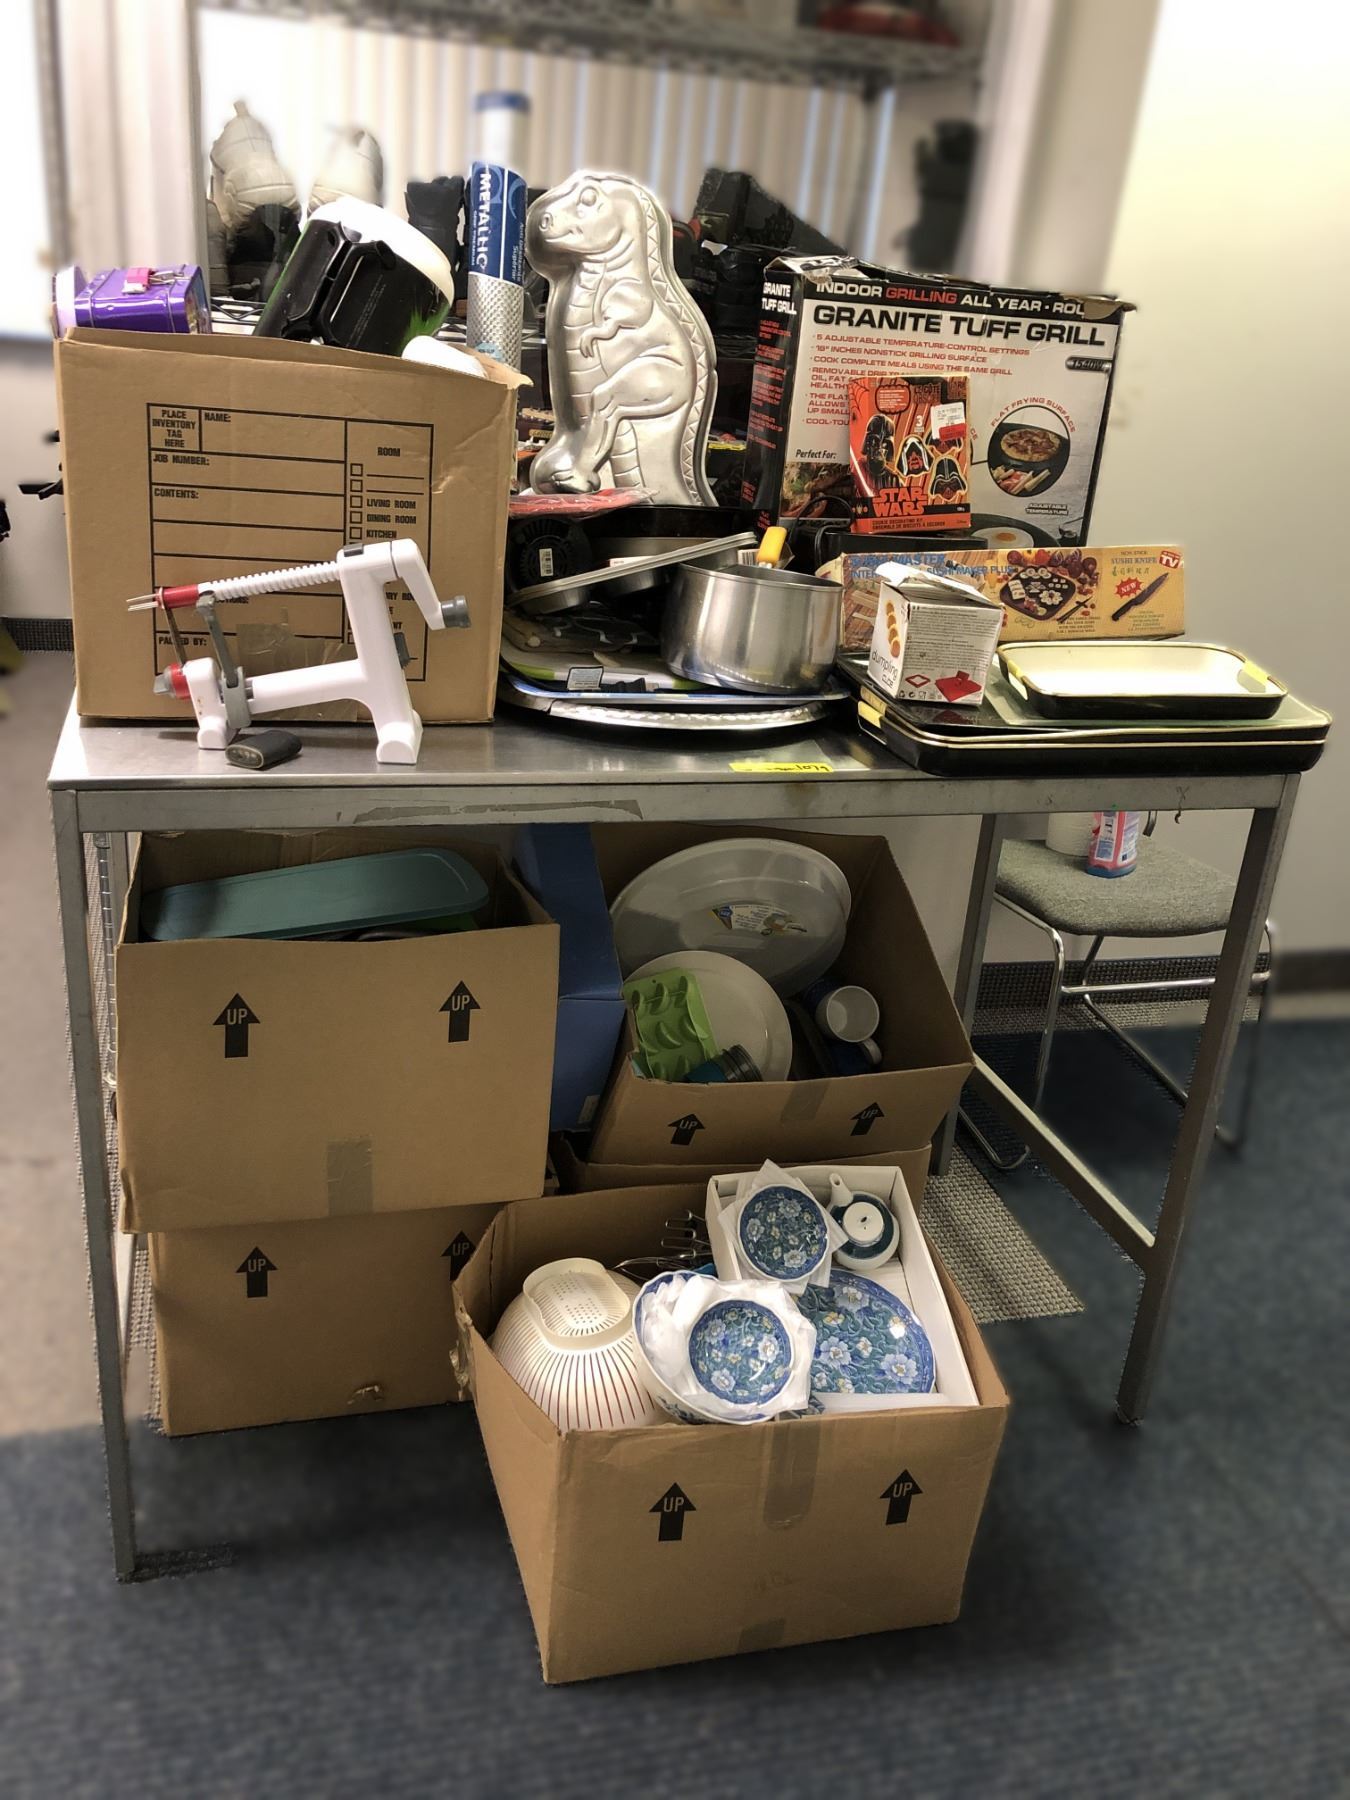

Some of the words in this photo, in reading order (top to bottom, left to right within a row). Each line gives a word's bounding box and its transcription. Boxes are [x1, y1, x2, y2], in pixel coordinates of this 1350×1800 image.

[763, 282, 791, 297] GRANITE
[816, 282, 882, 298] INDOOR
[886, 287, 958, 304] GRILLING
[960, 294, 992, 308] ALL
[998, 298, 1042, 312] YEAR
[762, 298, 777, 311] TUFF
[778, 300, 797, 315] GRILL
[814, 304, 943, 334] GRANITE
[950, 316, 1022, 339] TUFF
[1026, 322, 1105, 346] GRILL
[824, 335, 882, 345] ADJUSTABLE
[988, 348, 1030, 356] SETTINGS
[830, 346, 862, 354] INCHES
[864, 348, 906, 357] NONSTICK
[909, 352, 946, 360] GRILLING
[948, 354, 987, 363] SURFACE
[812, 367, 865, 376] REMOVABLE
[814, 356, 840, 364] COOK
[840, 358, 887, 367] COMPLETE
[888, 360, 917, 369] MEALS
[918, 362, 944, 371] USING
[946, 364, 962, 372] THE
[964, 366, 988, 374] SAME
[990, 368, 1013, 376] GRILL
[810, 392, 826, 400] THE
[808, 400, 846, 408] ALLOWS
[162, 410, 186, 419] PLACE
[204, 413, 231, 422] NAME:
[991, 404, 1010, 427] FLAT
[1012, 397, 1045, 408] FRYING
[1046, 399, 1076, 433] SURFACE
[152, 419, 196, 430] INVENTORY
[916, 416, 922, 426] 3
[166, 429, 182, 438] TAG
[164, 439, 185, 448] HERE
[378, 447, 400, 457] ROOM
[796, 449, 821, 459] Perfect
[822, 450, 836, 460] For:
[153, 454, 168, 463] JOB
[172, 455, 210, 466] NUMBER:
[154, 488, 199, 499] CONTENTS:
[874, 486, 928, 502] STAR
[366, 498, 390, 508] LIVING
[394, 500, 416, 509] ROOM
[874, 501, 928, 517] WARS
[366, 514, 391, 523] DINING
[395, 515, 416, 524] ROOM
[366, 530, 397, 538] KITCHEN
[1160, 554, 1179, 568] TV
[957, 566, 987, 575] MAKER
[1121, 581, 1137, 594] NEW
[193, 638, 206, 646] BY:
[872, 650, 898, 680] dumpling
[452, 994, 470, 1011] UP
[228, 1008, 248, 1025] UP
[861, 1109, 878, 1120] UP
[680, 1120, 698, 1130] UP
[452, 1242, 469, 1256] UP
[248, 1258, 266, 1273] UP
[893, 1482, 913, 1498] UP
[664, 1496, 684, 1512] UP
